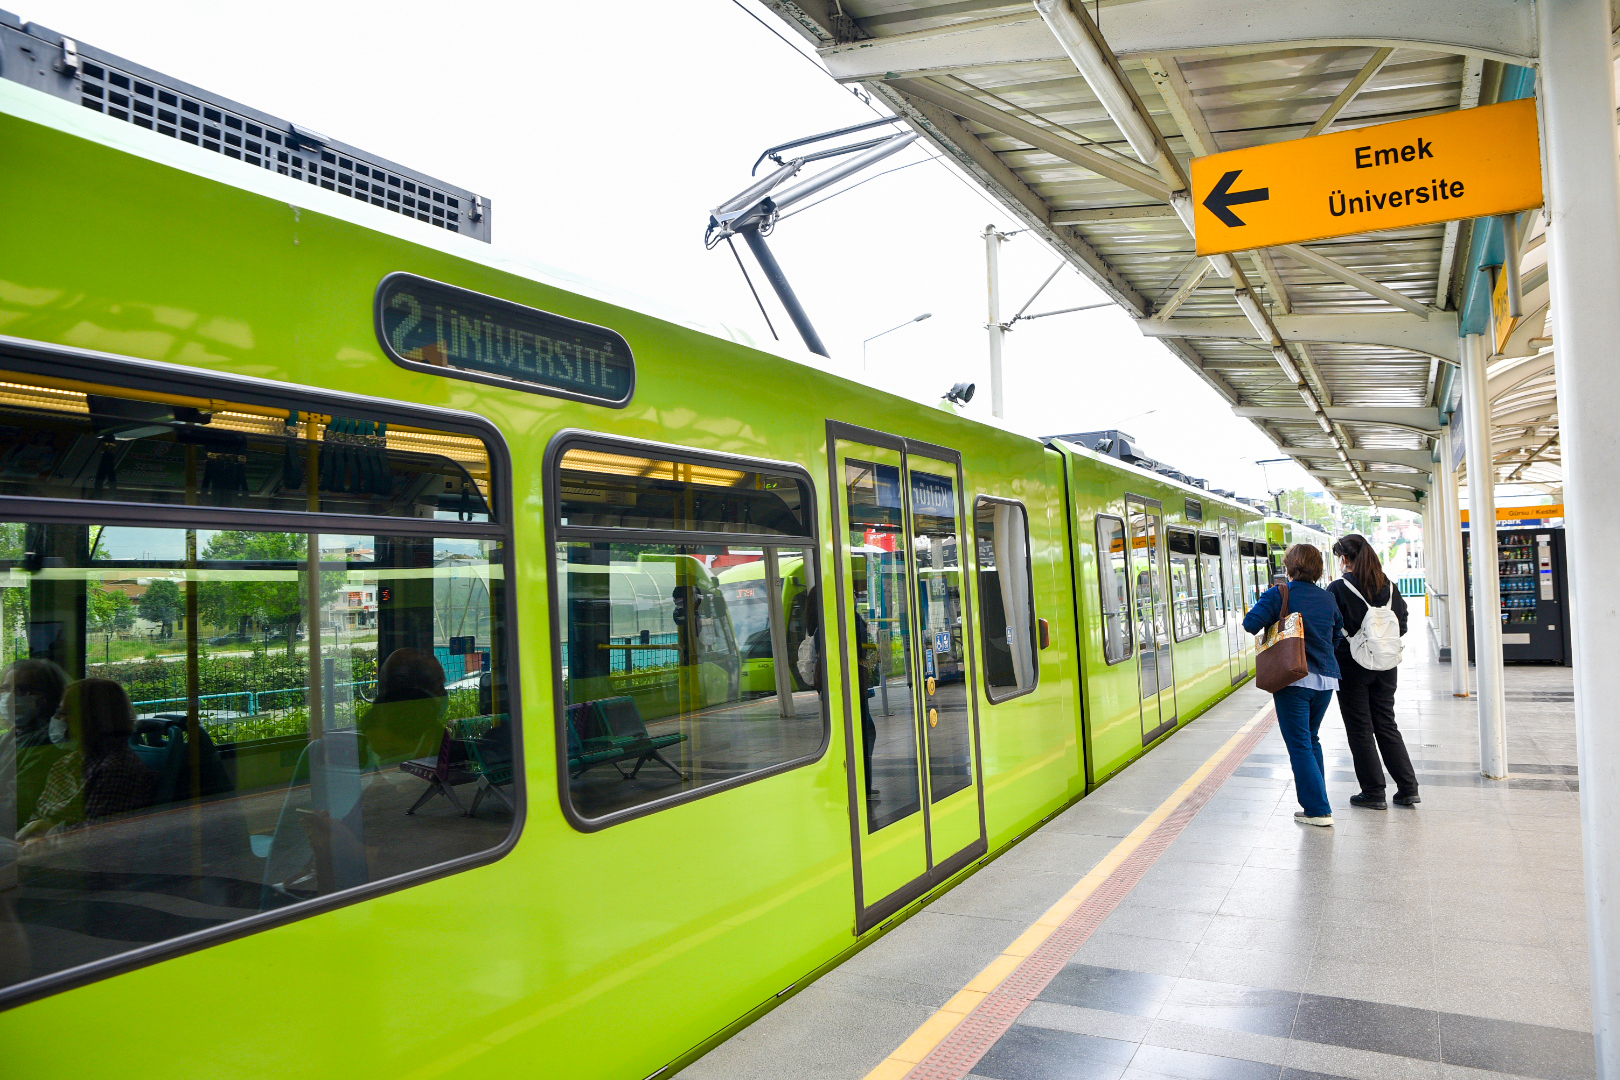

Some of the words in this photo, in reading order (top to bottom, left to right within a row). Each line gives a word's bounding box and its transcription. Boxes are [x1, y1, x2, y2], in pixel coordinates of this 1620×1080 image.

[1355, 138, 1433, 169] Emek
[1329, 179, 1465, 217] Üniversite
[392, 292, 423, 360] 2
